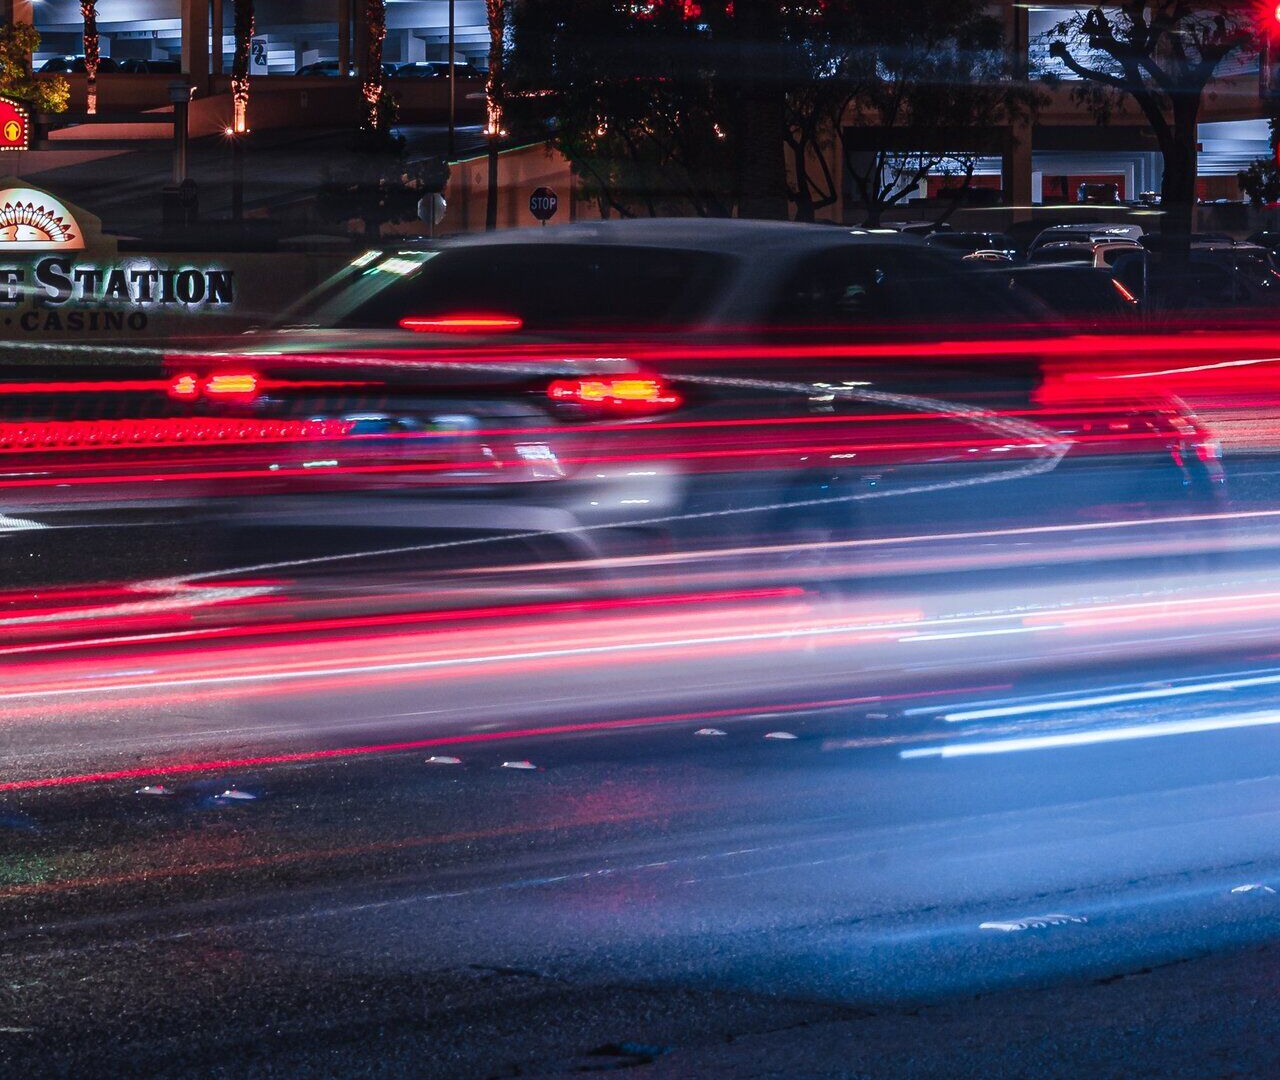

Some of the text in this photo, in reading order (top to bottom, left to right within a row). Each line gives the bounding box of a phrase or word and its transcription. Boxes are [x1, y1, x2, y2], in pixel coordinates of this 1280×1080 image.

[257, 56, 266, 65] A
[531, 197, 556, 210] STOP
[36, 256, 234, 304] STATION
[20, 311, 148, 332] CASINO
